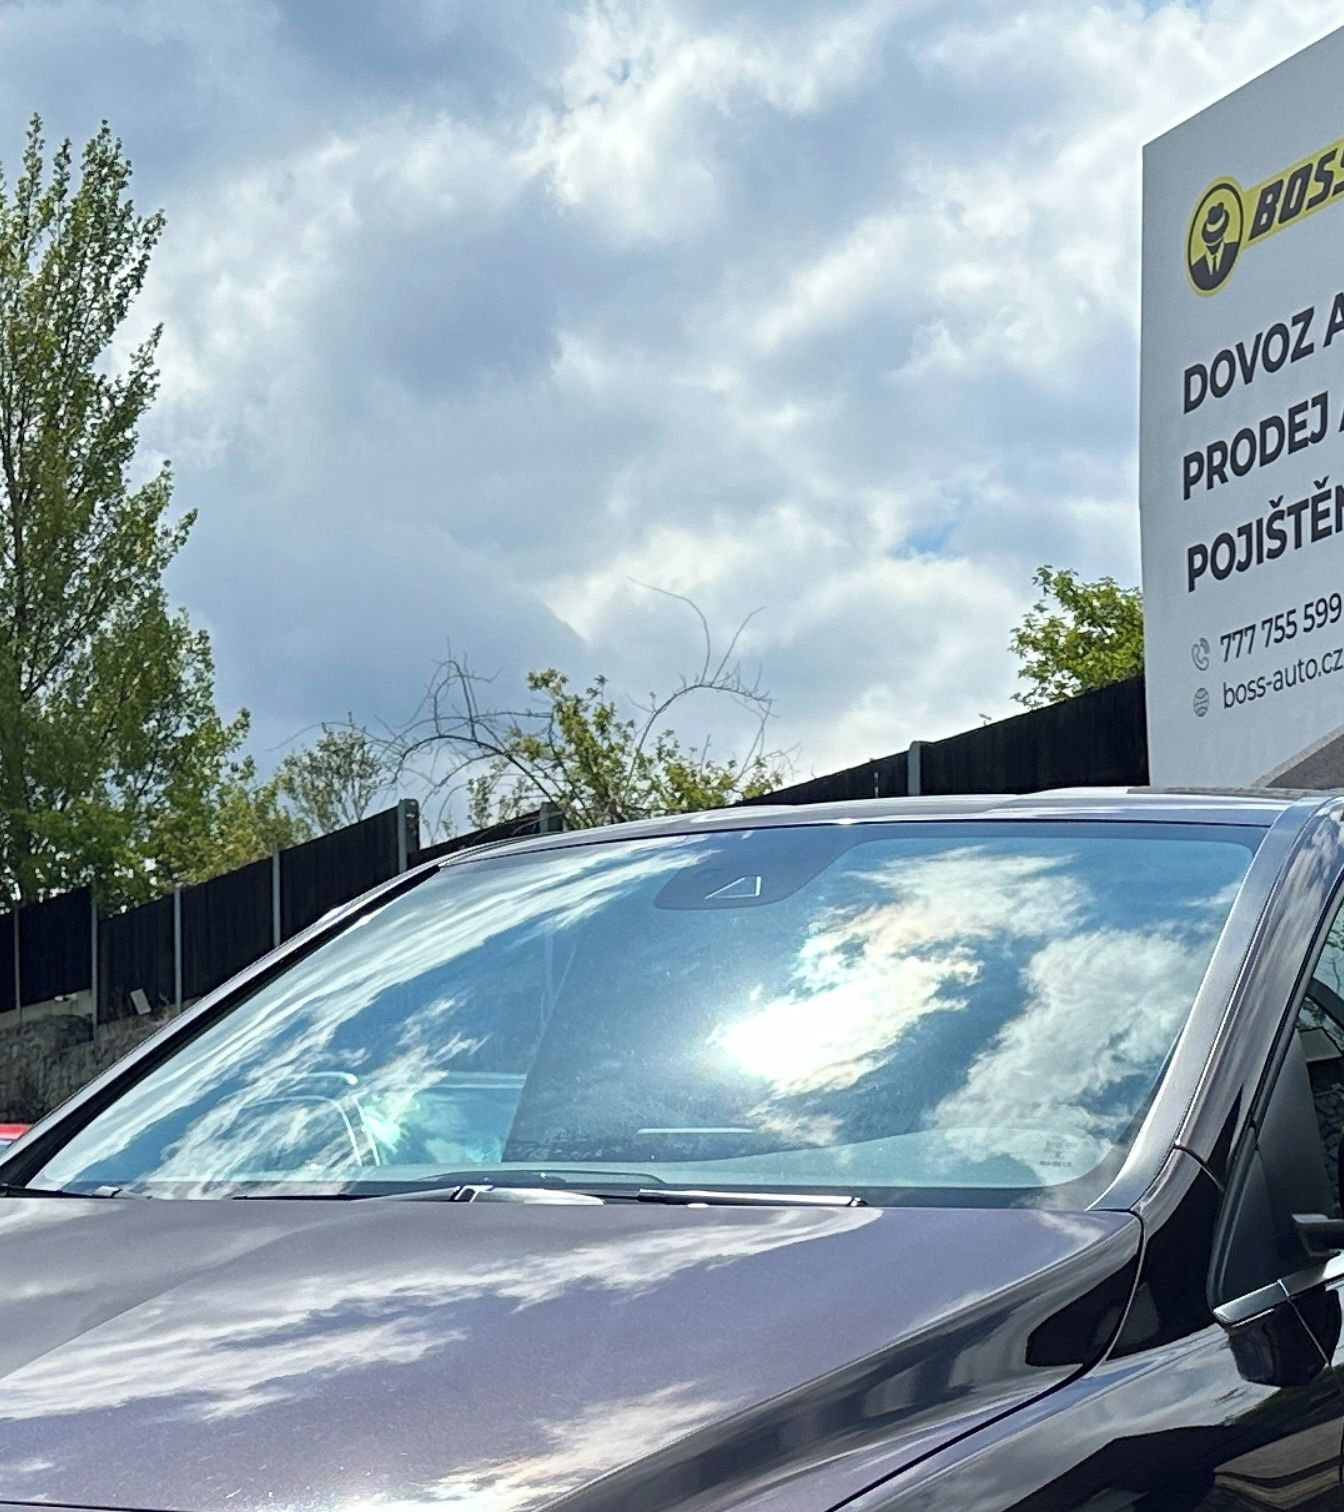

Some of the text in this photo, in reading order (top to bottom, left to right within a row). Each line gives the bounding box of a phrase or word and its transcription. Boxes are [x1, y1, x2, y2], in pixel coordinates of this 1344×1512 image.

[1184, 305, 1316, 414] DOVOZ
[1183, 393, 1330, 501] PRODEJ
[1219, 592, 1343, 664] 777 755 599
[1223, 647, 1344, 709] boss-auto.cz
